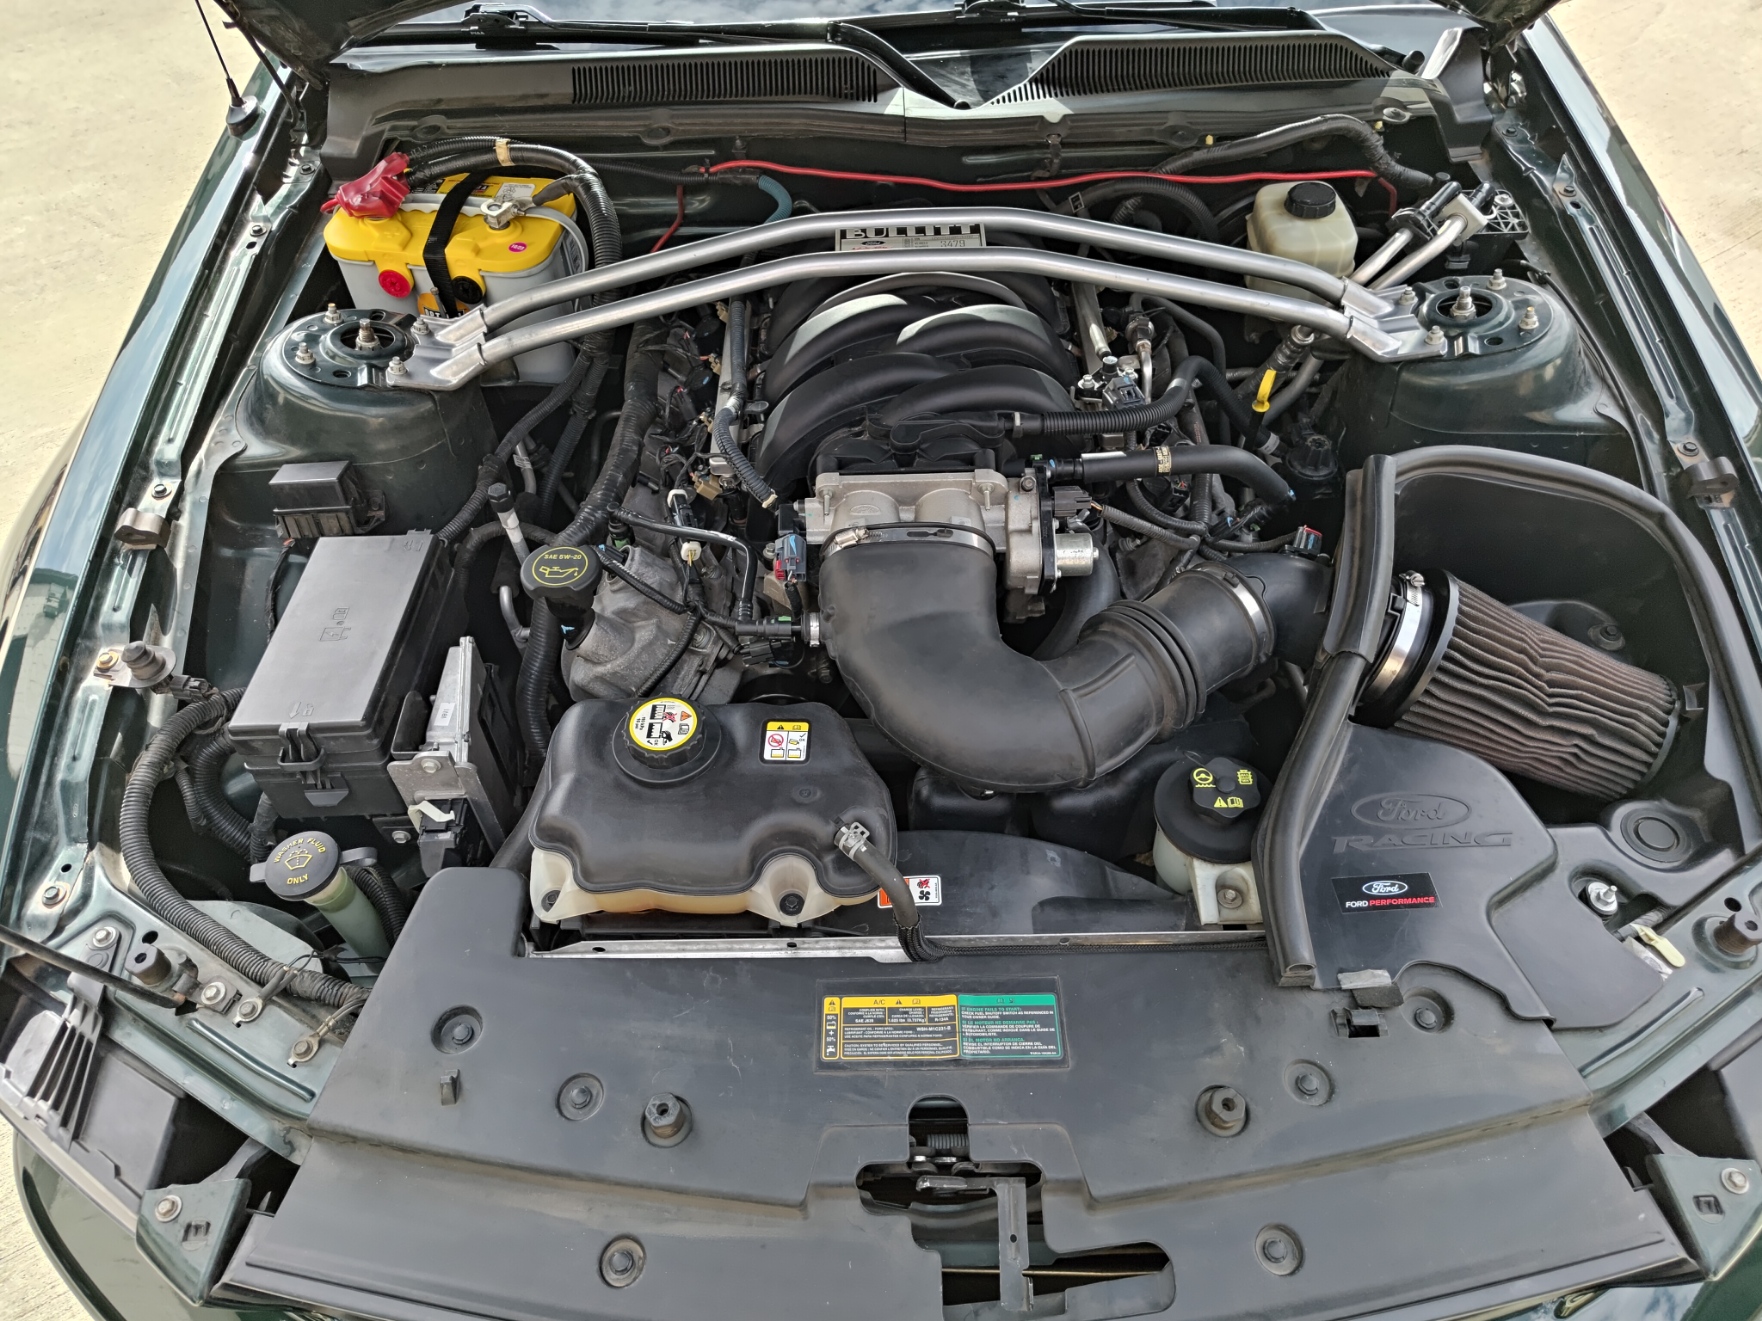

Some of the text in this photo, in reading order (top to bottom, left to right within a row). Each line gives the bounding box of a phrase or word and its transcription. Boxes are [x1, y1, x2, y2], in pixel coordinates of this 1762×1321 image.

[1377, 797, 1445, 821] Ford
[274, 838, 326, 863] WASHER FLUID
[1331, 832, 1512, 854] RACING
[286, 874, 309, 885] ONLY
[1371, 882, 1400, 894] Ford
[1346, 896, 1435, 908] FORD PERFORMANCE
